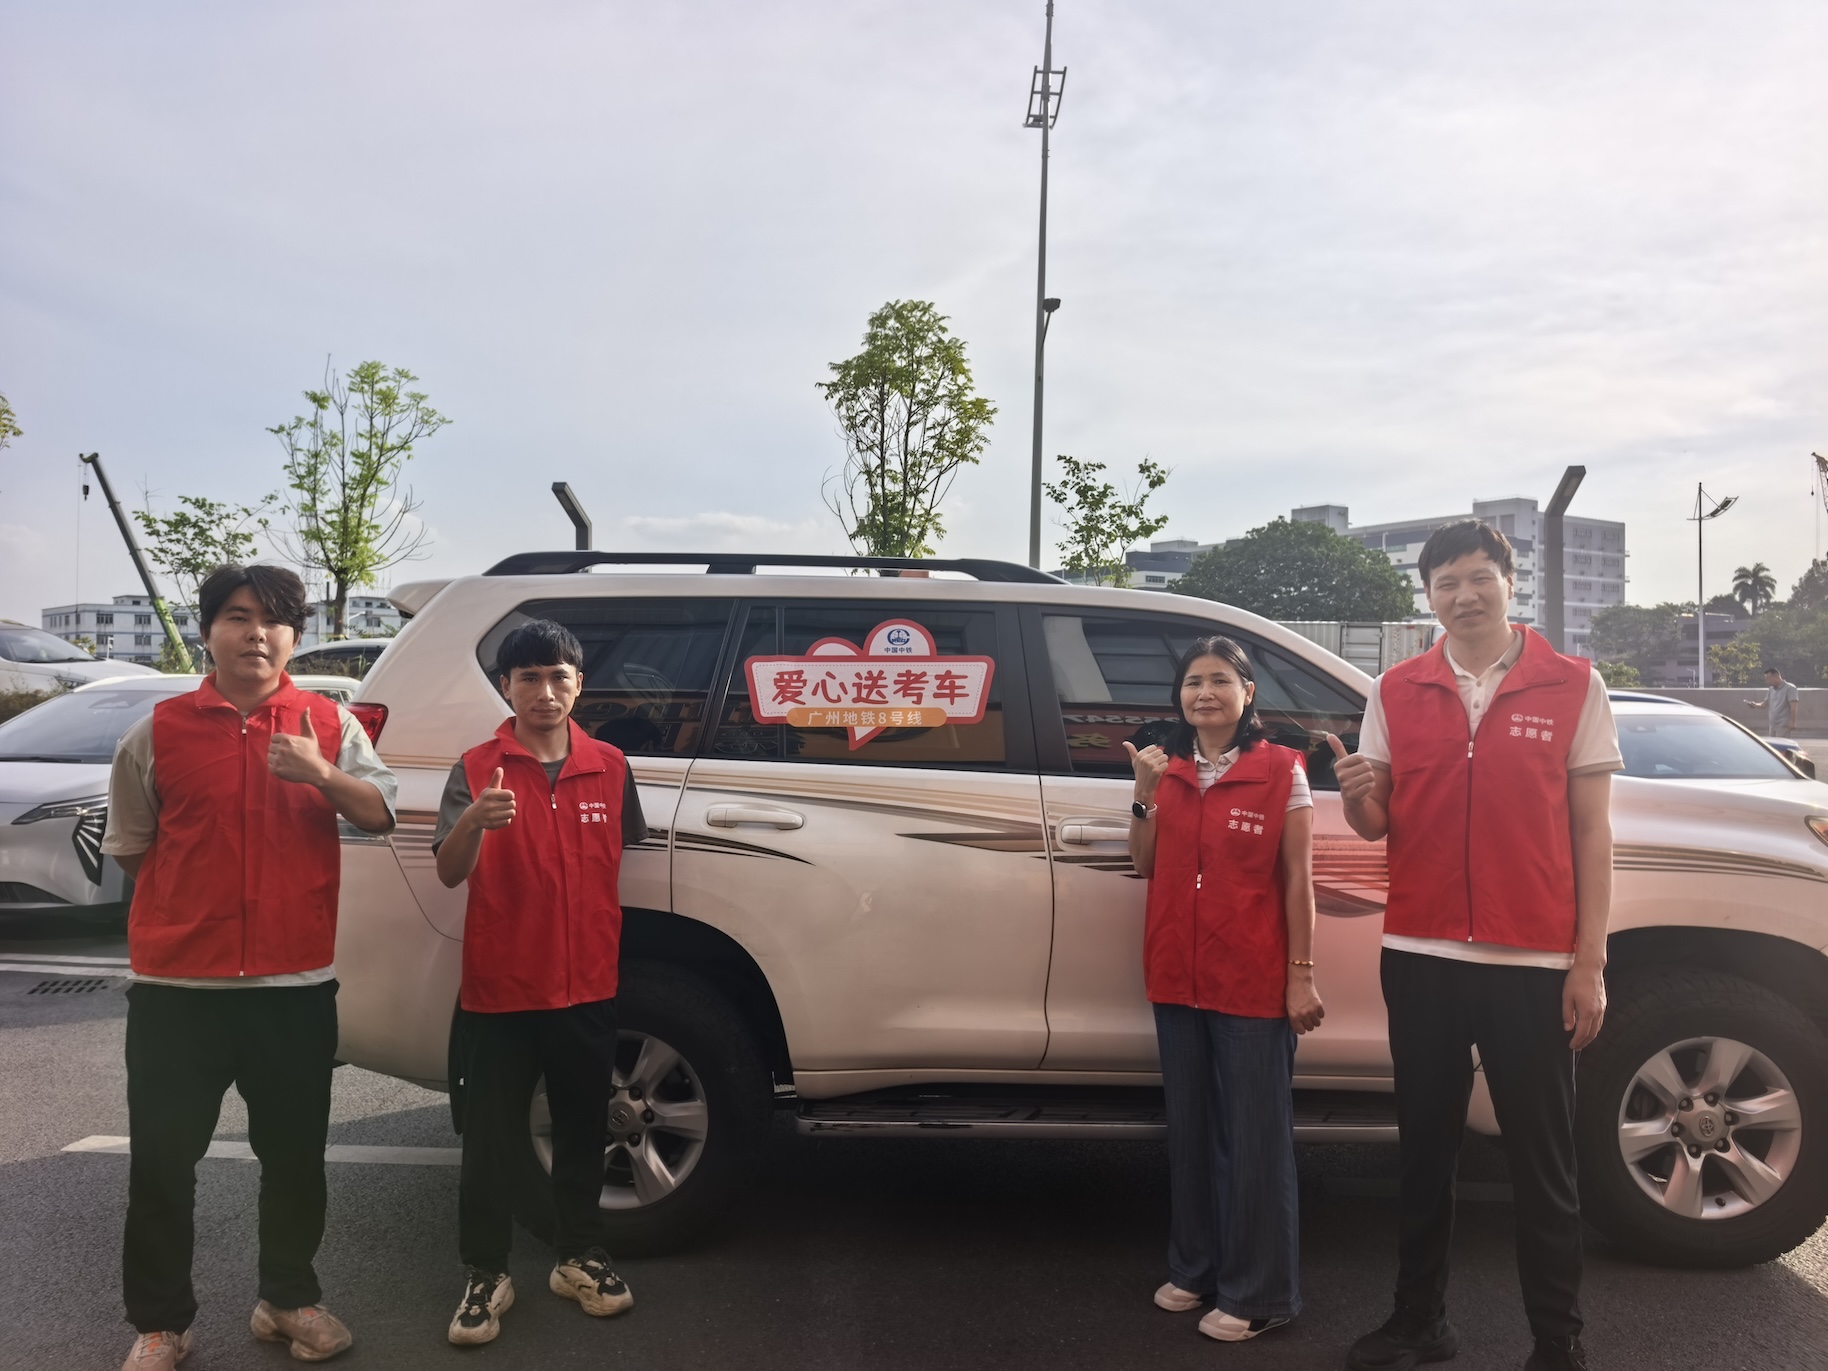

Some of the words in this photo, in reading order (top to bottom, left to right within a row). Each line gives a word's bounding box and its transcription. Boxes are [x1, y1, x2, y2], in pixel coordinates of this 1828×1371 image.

[884, 646, 913, 654] 中国中铁
[772, 670, 970, 705] 爱心送考车
[807, 710, 923, 726] 广州地铁8号线
[1509, 726, 1553, 742] 志愿者
[1228, 820, 1263, 835] 志愿者
